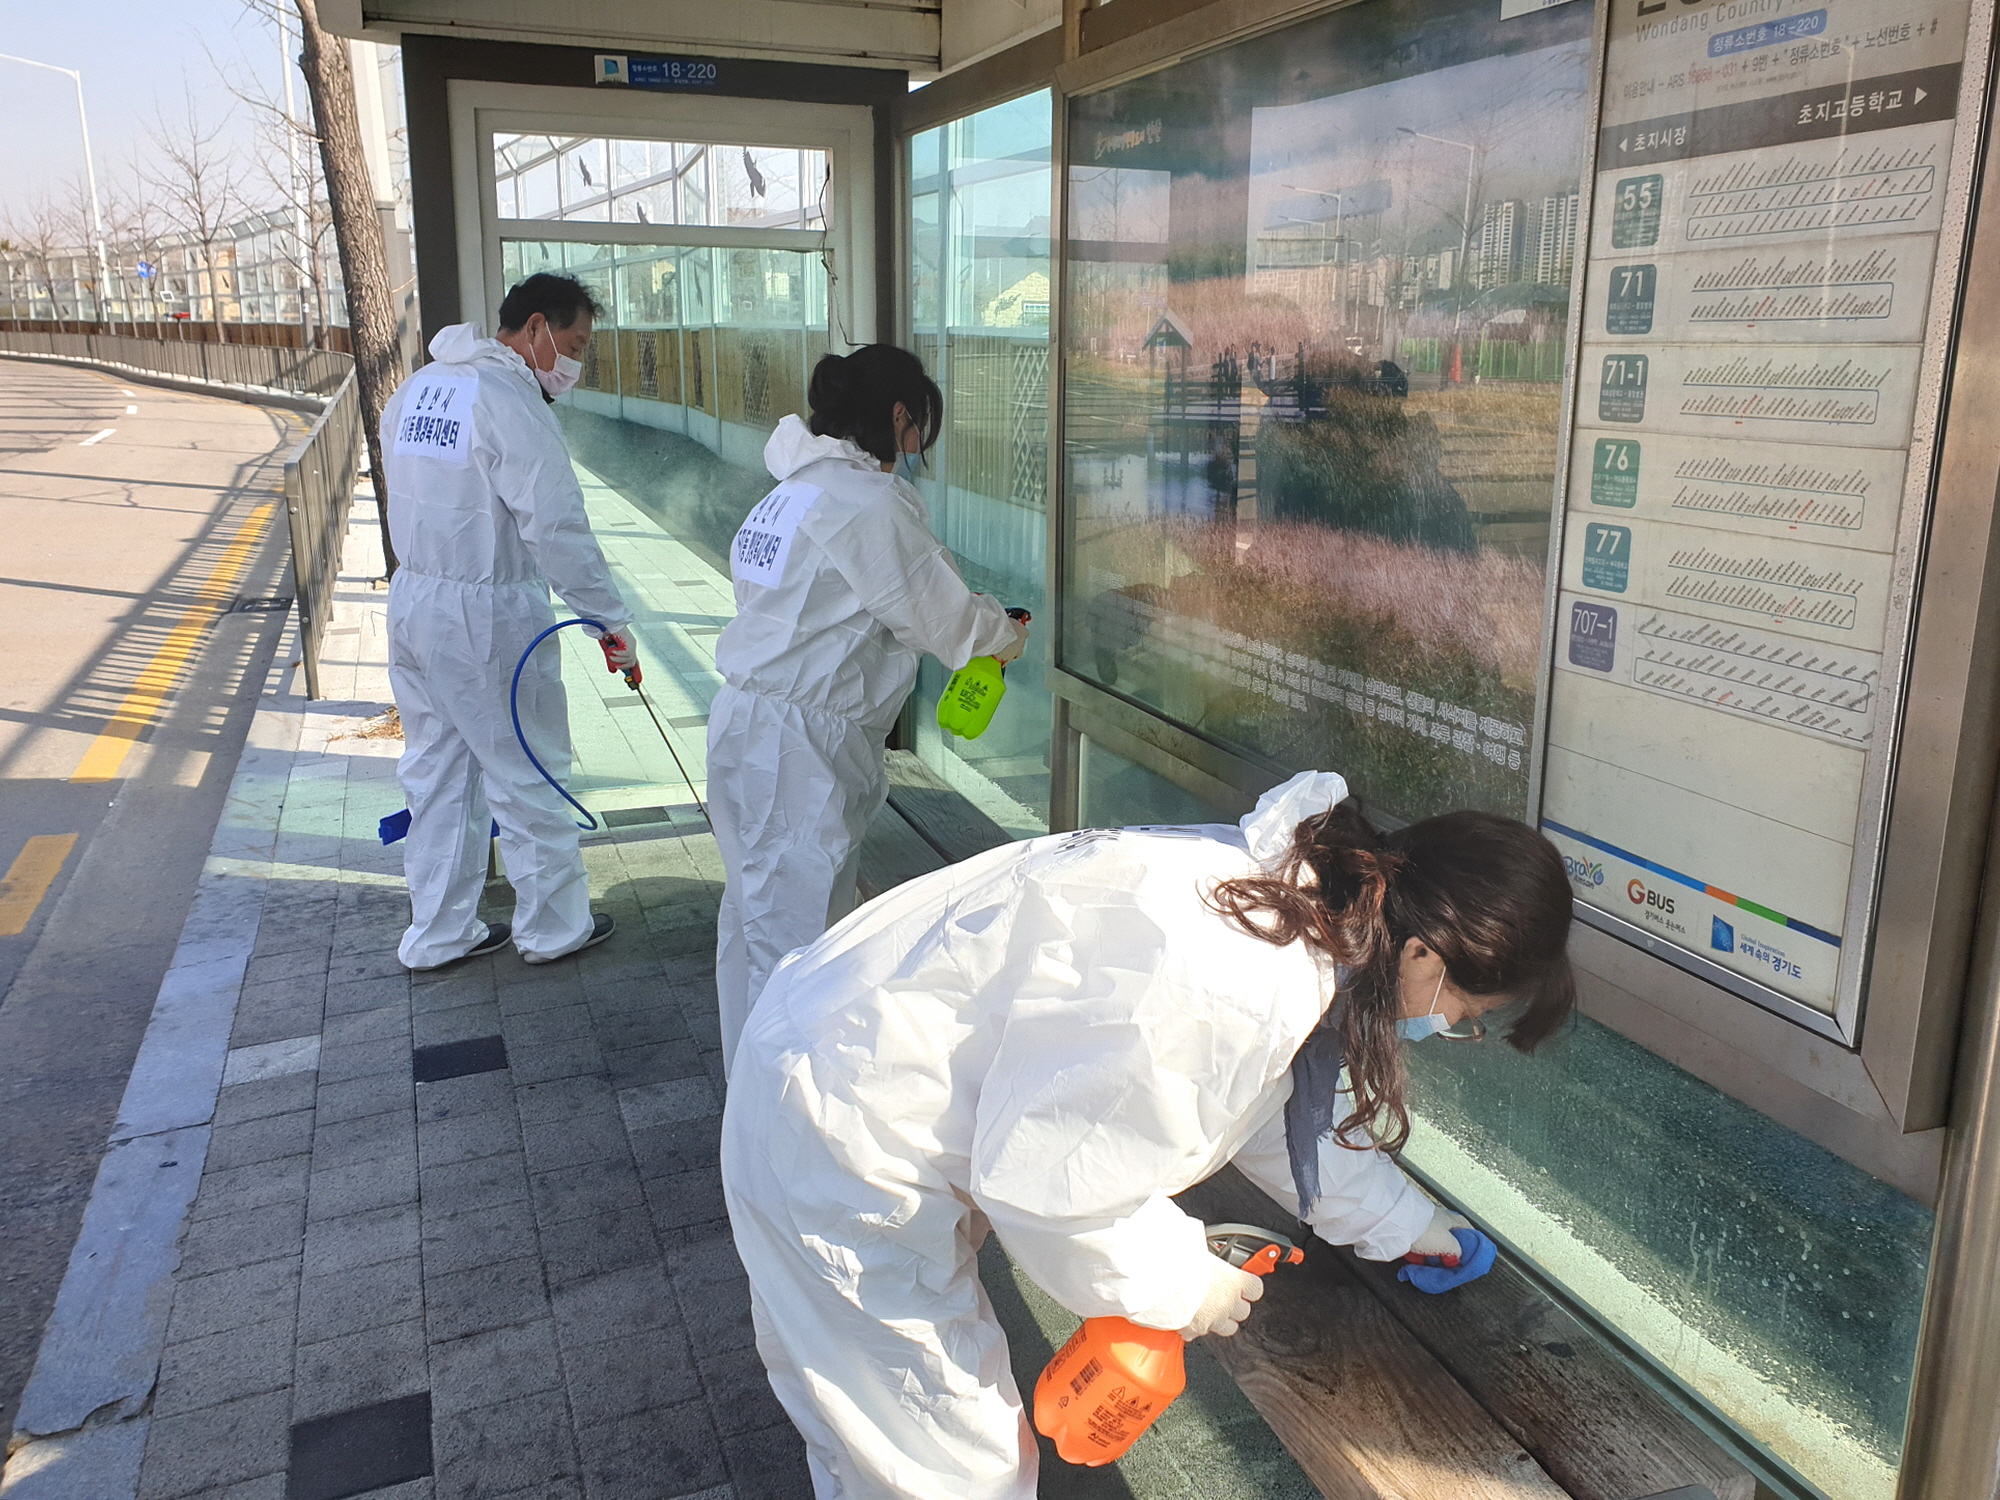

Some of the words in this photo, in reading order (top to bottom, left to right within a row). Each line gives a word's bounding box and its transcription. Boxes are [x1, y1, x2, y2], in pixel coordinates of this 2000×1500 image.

[1636, 12, 1708, 42] Wondang
[1716, 0, 1782, 22] Country
[1713, 27, 1768, 52] 정류소번호
[1774, 16, 1819, 36] 18-220
[1753, 54, 1768, 73] 9번
[1864, 23, 1911, 49] 노선번호
[662, 62, 717, 79] 18-220
[1797, 90, 1903, 125] 초지고등학교
[1633, 126, 1687, 152] 초지시장
[1623, 182, 1652, 211] 55
[1620, 271, 1643, 297] 71
[1606, 360, 1643, 385] 71-1
[1605, 444, 1628, 471] 76
[1596, 529, 1622, 555] 77
[1574, 609, 1613, 639] 707-1
[1405, 690, 1435, 716] 생물의
[1437, 702, 1476, 731] 서식지를
[1479, 716, 1523, 746] 제공하고
[1377, 702, 1404, 728] 심미적
[1430, 722, 1450, 744] 조류
[1508, 750, 1521, 771] 등
[1772, 956, 1802, 979] 경기도
